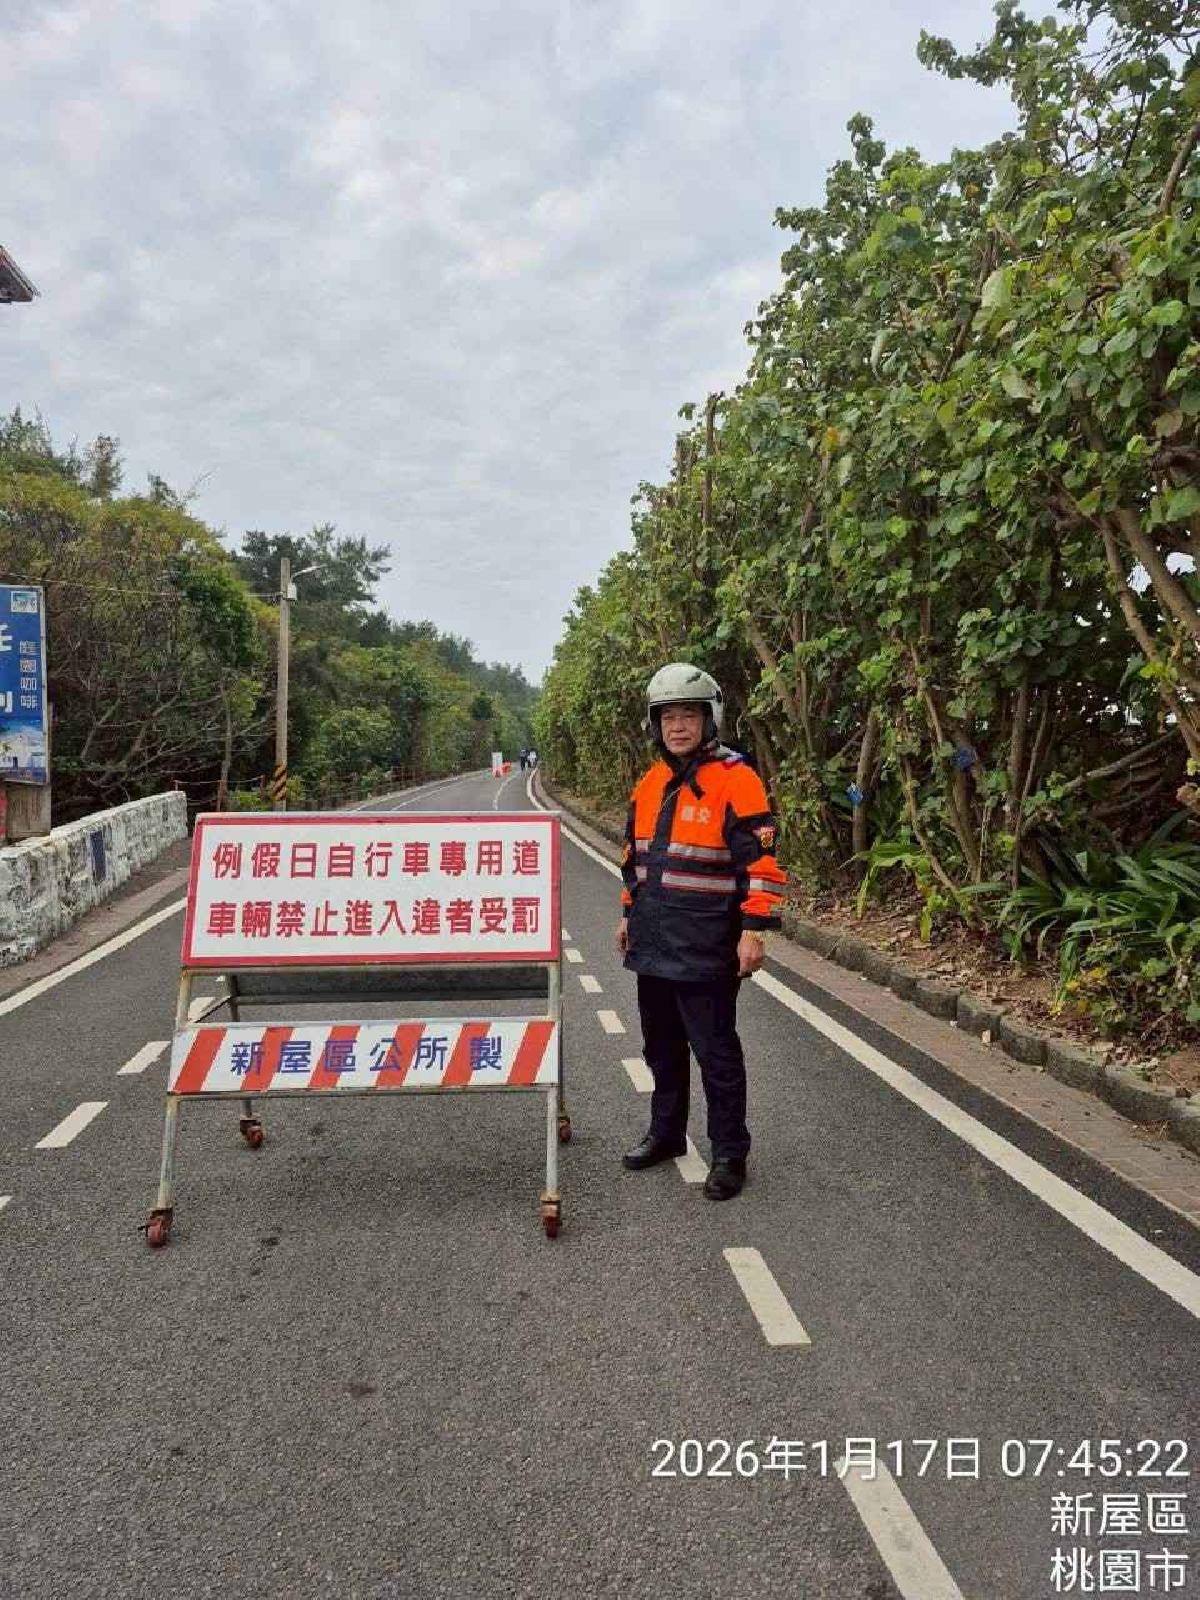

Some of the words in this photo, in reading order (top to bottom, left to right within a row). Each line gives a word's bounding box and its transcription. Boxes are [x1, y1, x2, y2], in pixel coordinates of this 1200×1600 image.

[212, 839, 541, 880] 例假日自行車專用道
[206, 896, 541, 938] 車輛禁止進入違者受罰
[230, 1035, 504, 1076] 新屋區公所製
